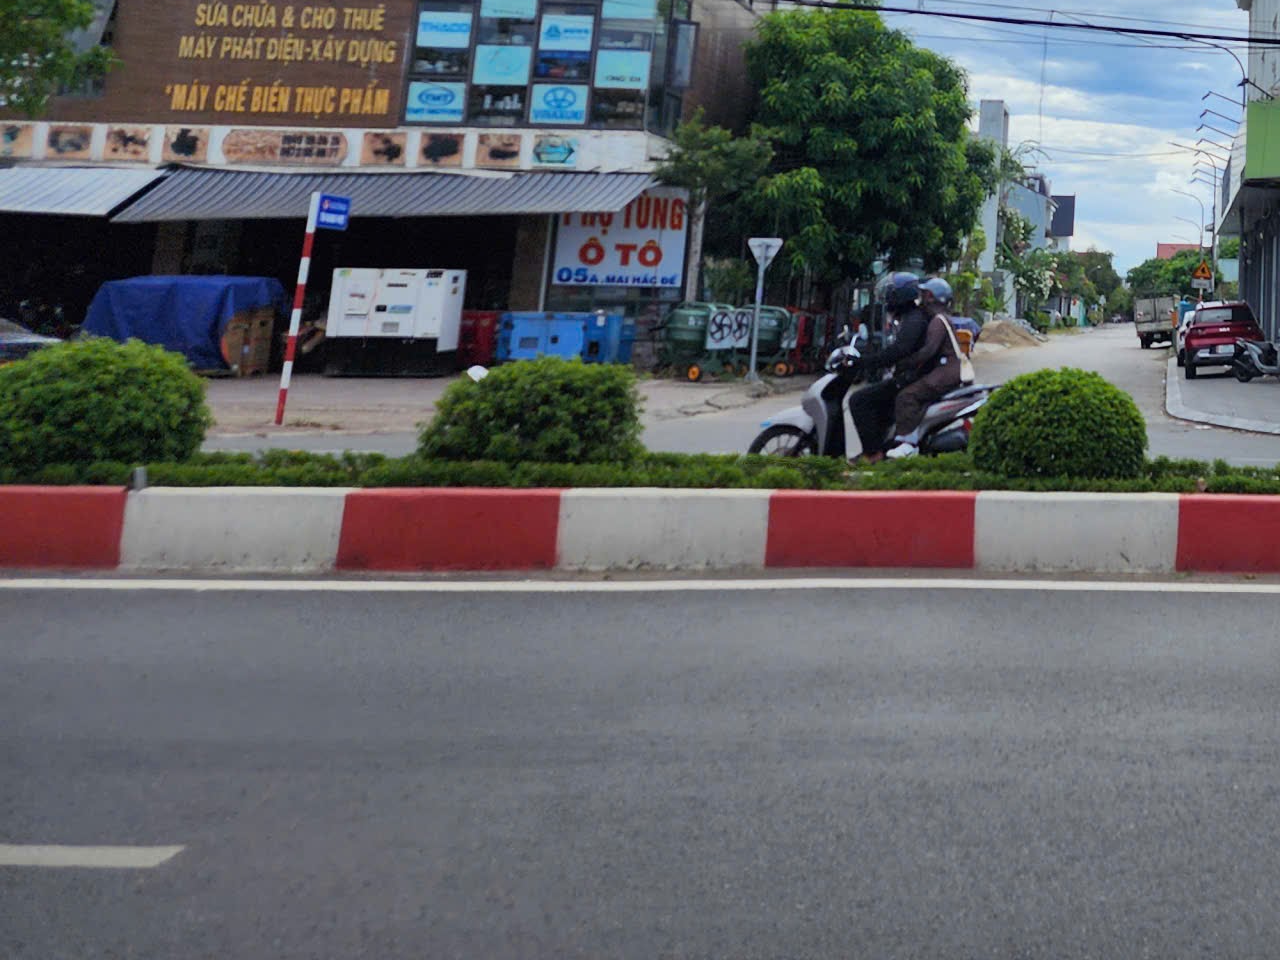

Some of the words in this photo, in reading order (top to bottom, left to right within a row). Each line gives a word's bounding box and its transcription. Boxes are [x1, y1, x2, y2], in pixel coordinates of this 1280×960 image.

[281, 5, 295, 28] &
[301, 6, 337, 29] CHO
[178, 31, 215, 58] MÁY
[220, 30, 264, 60] PHÁT
[347, 38, 398, 68] DỰNG
[214, 78, 251, 112] CHẾ
[251, 79, 291, 113] BIẾN
[295, 85, 336, 119] THỰC
[339, 79, 390, 114] PHẨM
[578, 236, 605, 266] Ô
[615, 239, 662, 268] TÔ
